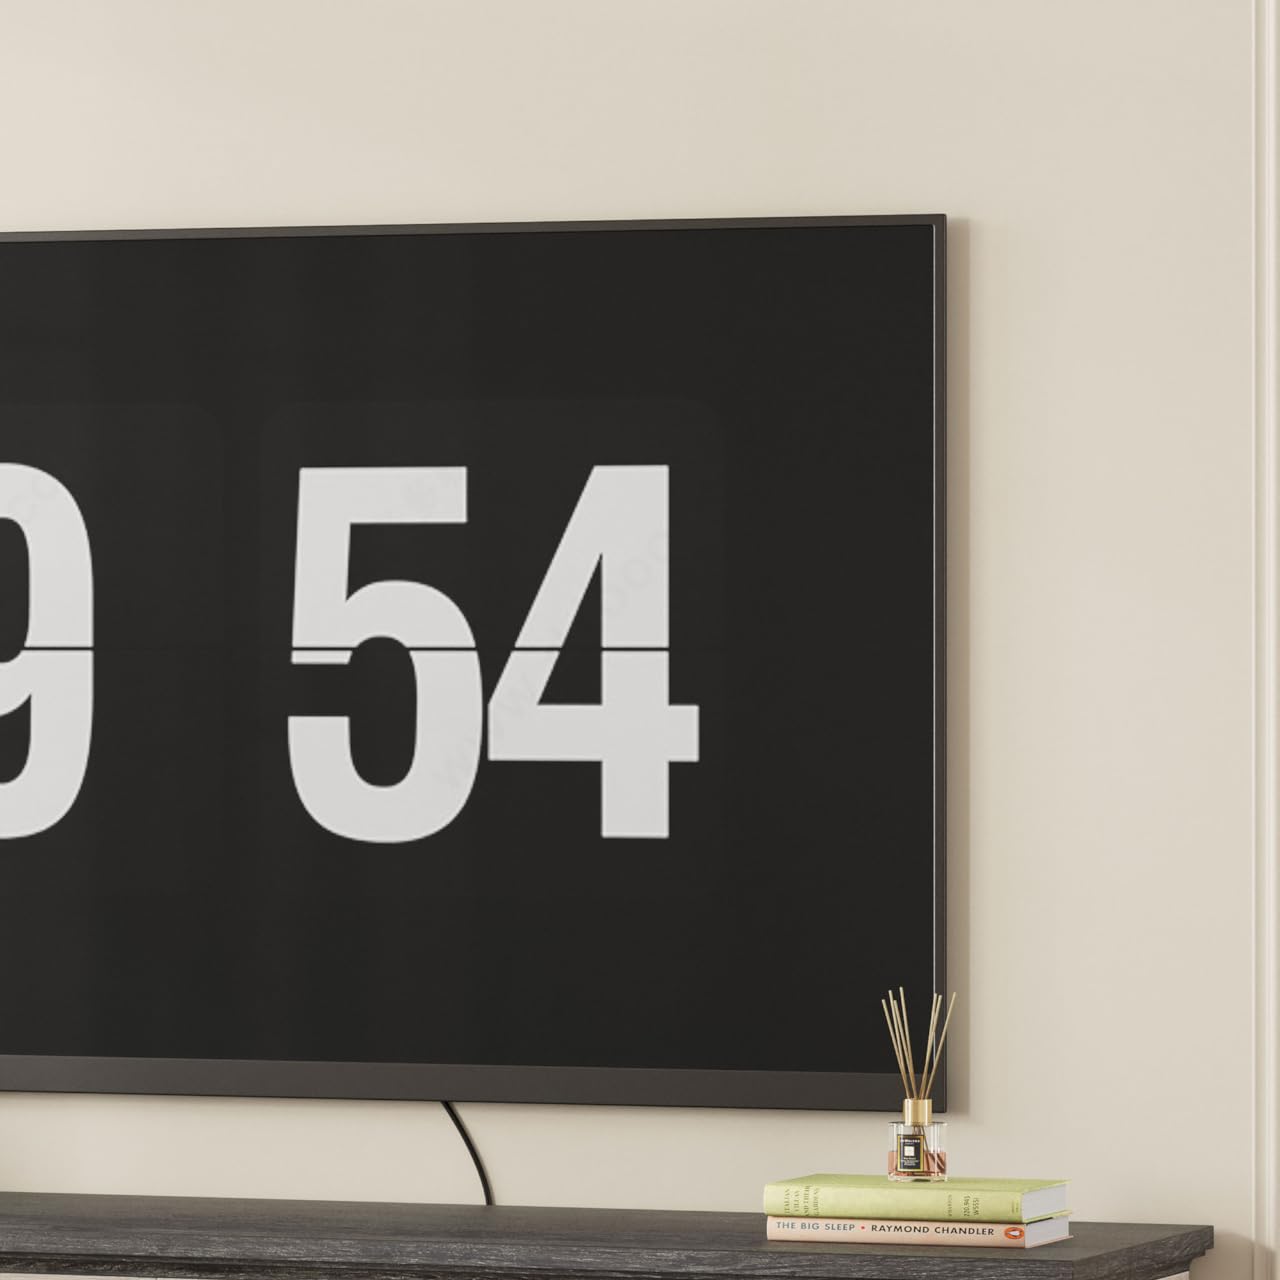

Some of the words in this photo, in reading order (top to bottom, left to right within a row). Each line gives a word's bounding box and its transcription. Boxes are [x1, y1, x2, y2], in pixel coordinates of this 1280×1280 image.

[288, 465, 700, 844] 54
[776, 1221, 796, 1230] THE
[800, 1222, 821, 1231] BIG
[824, 1223, 856, 1232] SLEEP
[871, 1224, 930, 1234] RAYMOND
[934, 1226, 995, 1236] CHANDLER
